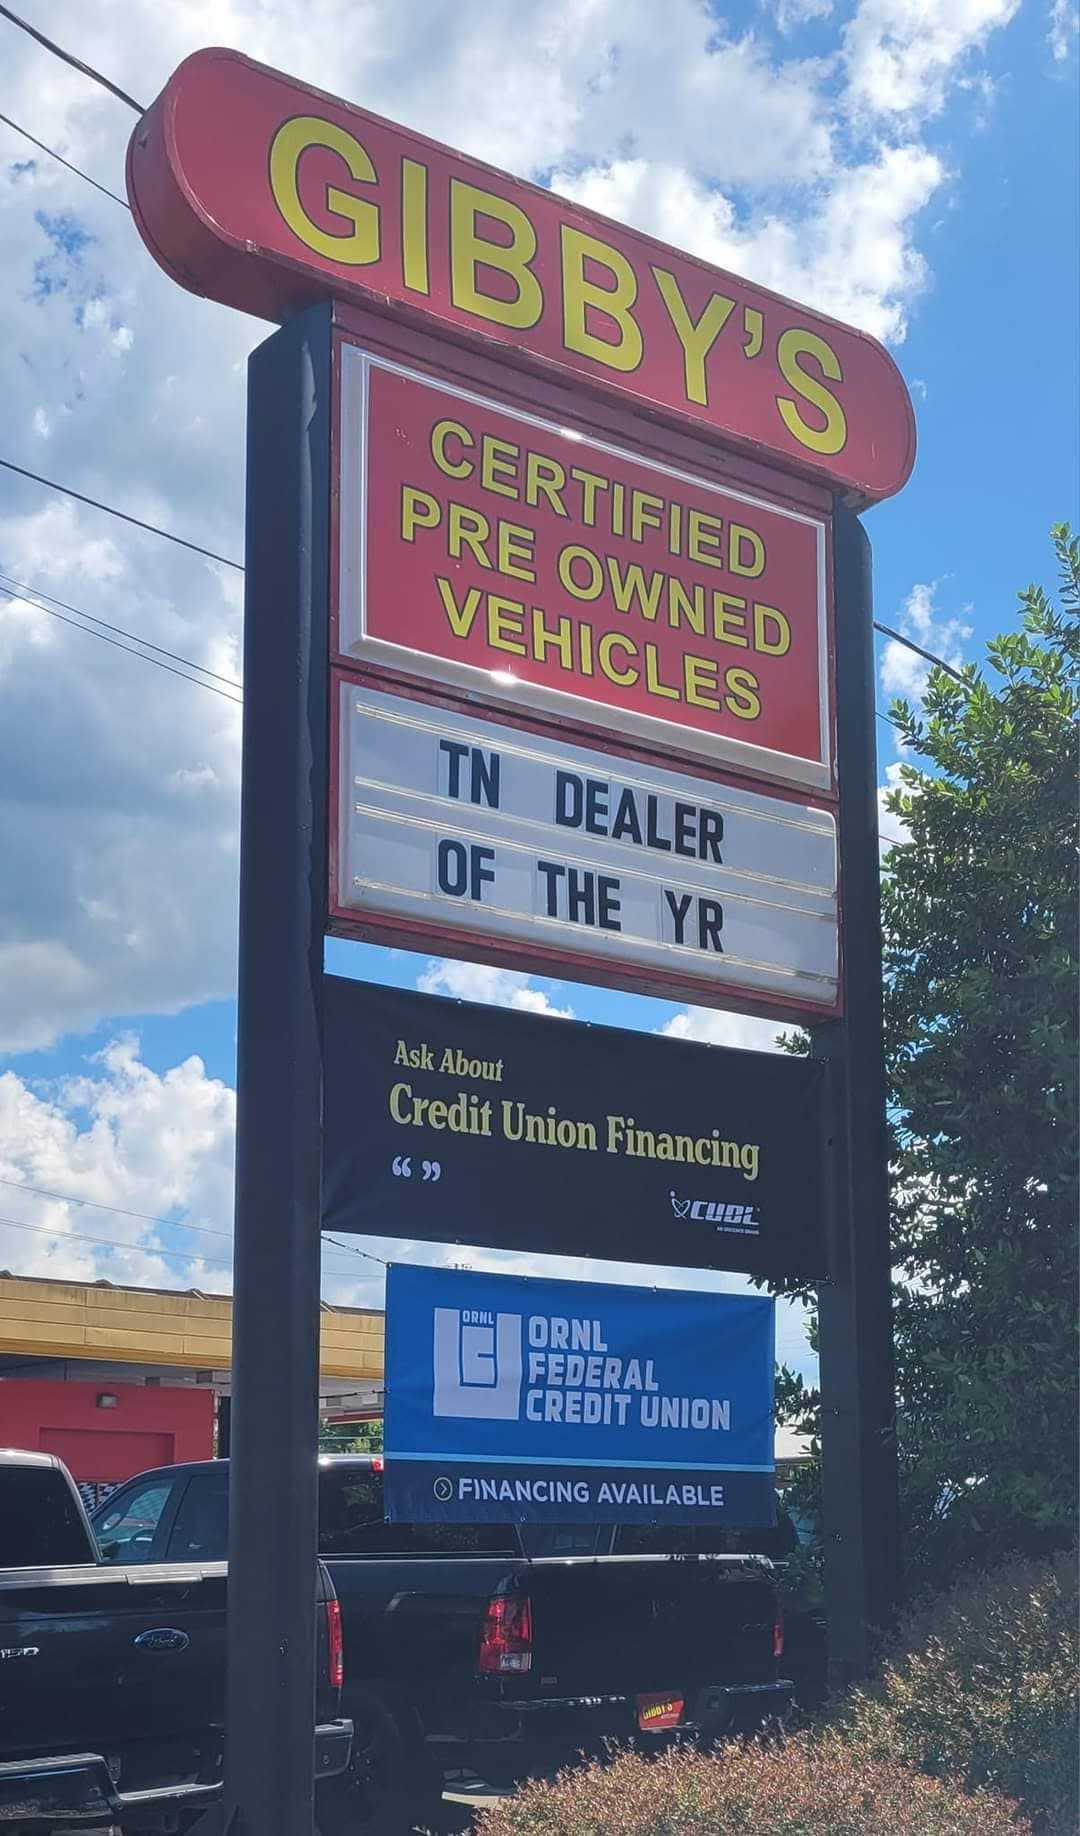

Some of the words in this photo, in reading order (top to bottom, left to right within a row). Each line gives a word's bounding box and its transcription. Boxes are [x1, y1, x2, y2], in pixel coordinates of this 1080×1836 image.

[268, 115, 848, 456] GIBBY'S
[430, 419, 766, 579] CERTIFIED
[400, 486, 537, 584] PRE
[557, 544, 791, 657] OWNED
[436, 577, 762, 721] VEHICLES
[439, 739, 501, 808] TN
[556, 770, 724, 864] DEALER
[438, 839, 496, 901] OF
[537, 860, 622, 932] THE
[664, 890, 724, 953] YR
[393, 1039, 434, 1071] Ask
[439, 1047, 504, 1082] About
[389, 1082, 492, 1137] Credit
[501, 1100, 598, 1151] Union
[606, 1115, 760, 1181] Financing
[462, 1310, 495, 1325] ORNL
[528, 1315, 608, 1352] ORNL
[526, 1389, 633, 1425] CREDIT
[640, 1395, 731, 1431] UNION
[528, 1351, 660, 1391] FEDERAL
[458, 1478, 590, 1504] FINANCING
[597, 1482, 725, 1506] AVAILABLE
